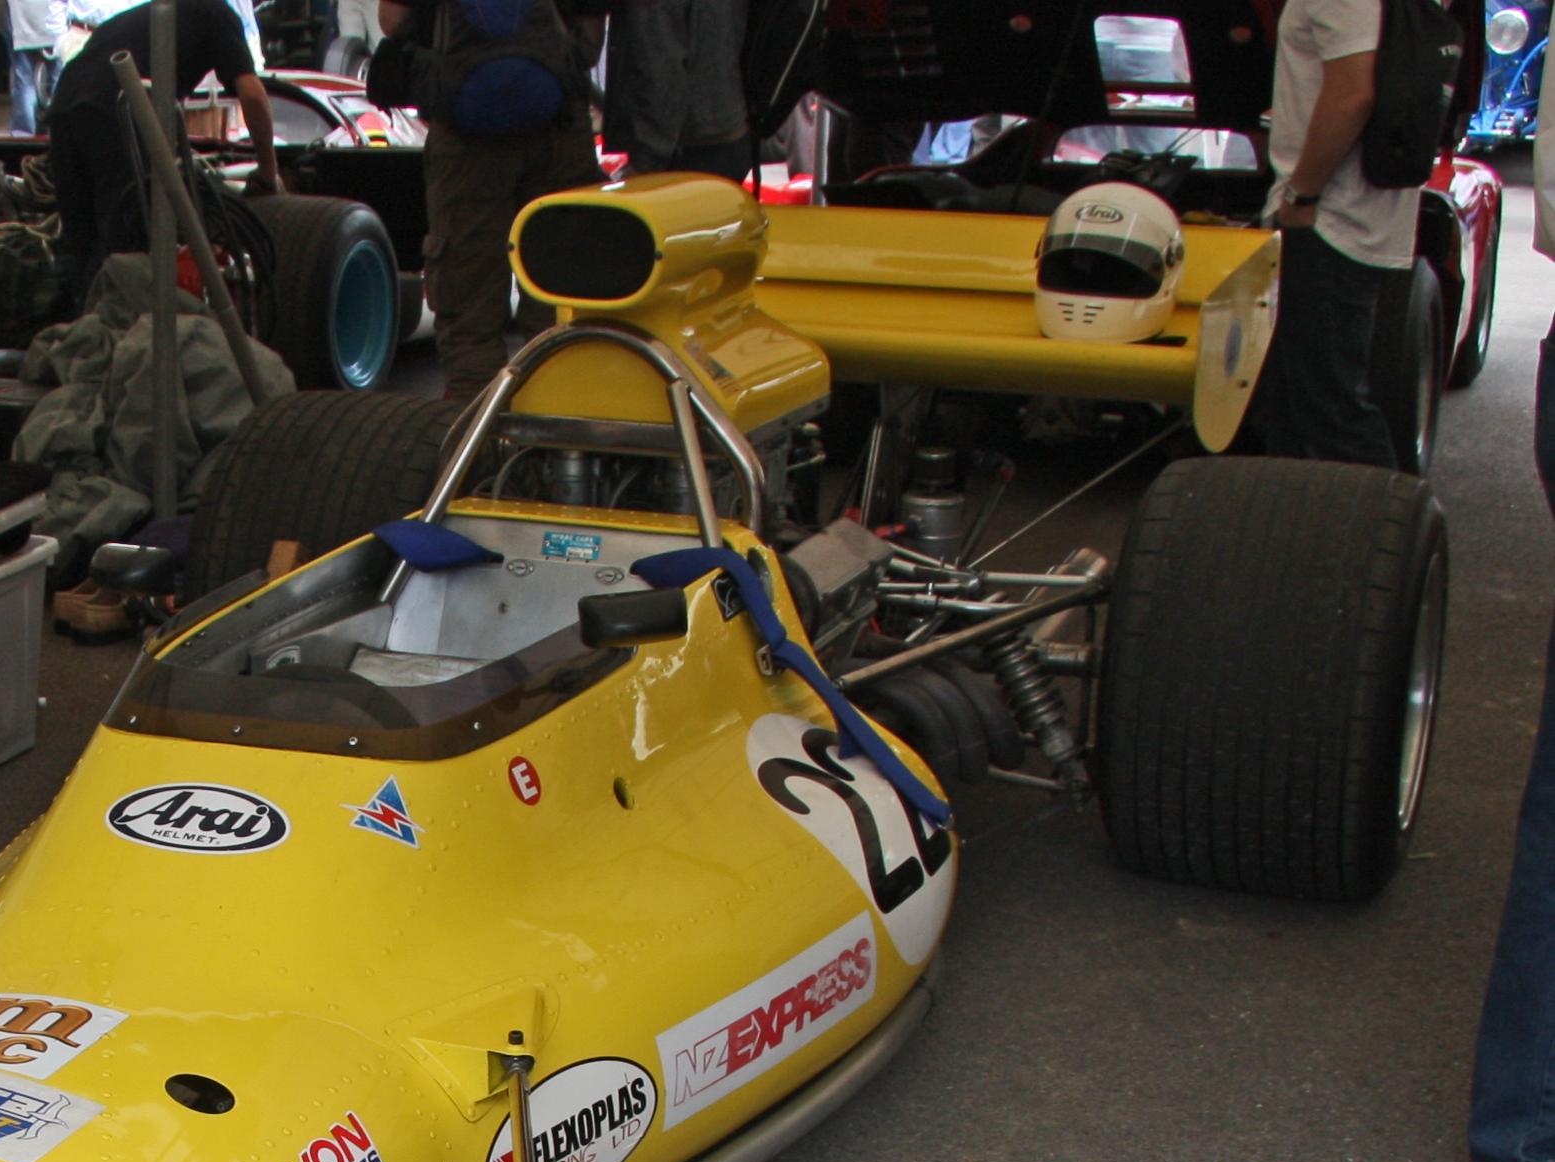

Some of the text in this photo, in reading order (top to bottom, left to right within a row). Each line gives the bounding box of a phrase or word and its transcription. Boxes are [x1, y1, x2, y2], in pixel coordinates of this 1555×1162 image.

[1083, 205, 1117, 220] Arai
[511, 762, 539, 800] E
[115, 791, 270, 838] Arai
[151, 829, 219, 845] HELMET
[612, 1118, 641, 1150] LTD
